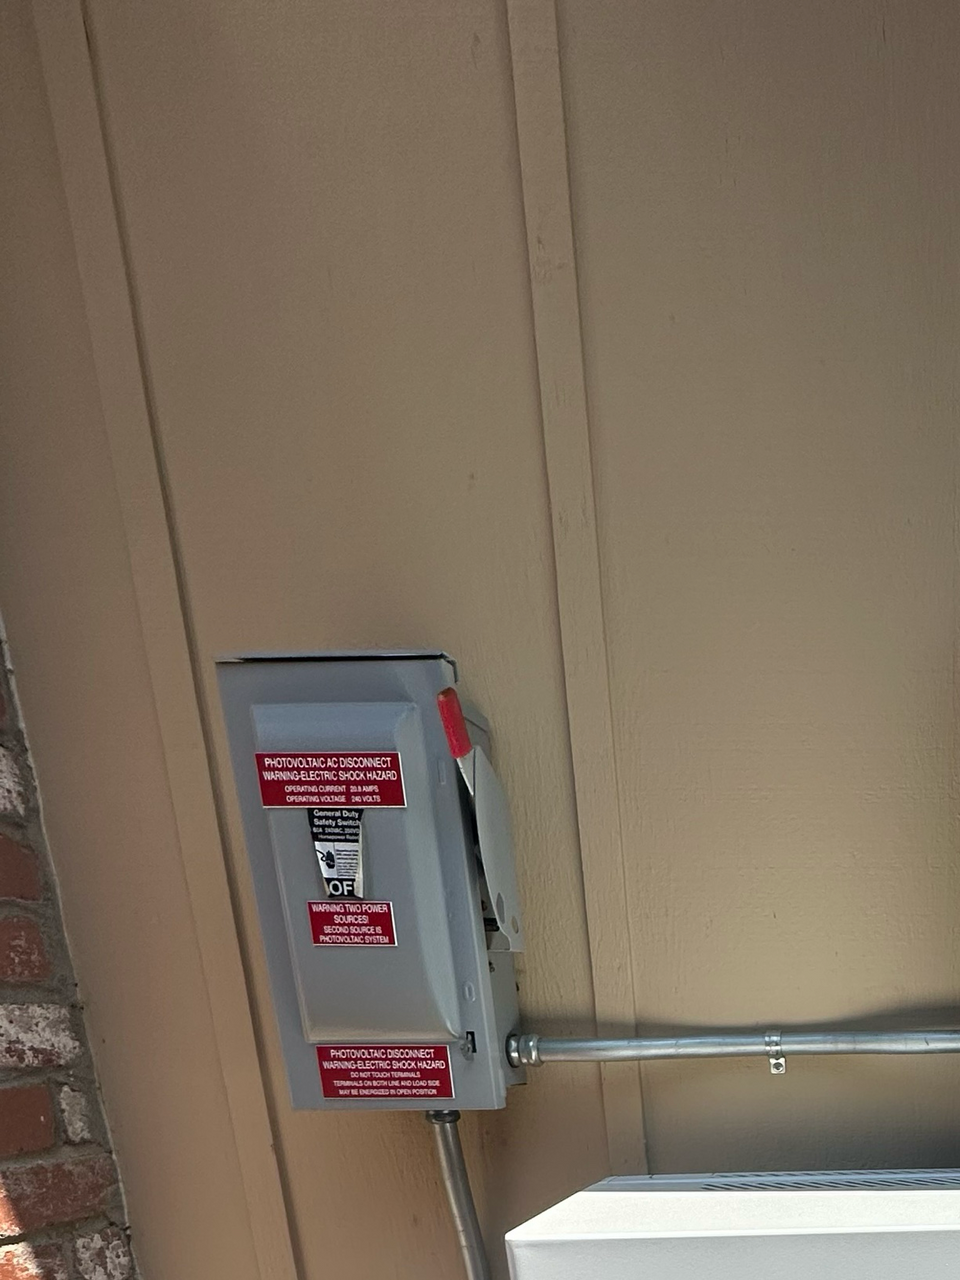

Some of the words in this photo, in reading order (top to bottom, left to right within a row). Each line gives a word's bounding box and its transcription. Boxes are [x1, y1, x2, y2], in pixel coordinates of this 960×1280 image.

[264, 757, 326, 768] PHOTOVOLTAIC
[327, 758, 338, 768] AC
[339, 758, 391, 768] DISCONNECT
[263, 771, 337, 780] WARNING-ELECTRIC
[339, 771, 365, 780] SHOCK
[367, 771, 397, 781] HAZARD
[342, 810, 359, 818] Duty
[312, 904, 344, 912] WARNING
[345, 904, 361, 912] TWO
[362, 904, 388, 913] POWER
[334, 915, 369, 923] SOURCES!
[320, 935, 364, 943] PHOTOVOLTAIC
[330, 1049, 386, 1058] PHOTOVOLTAIC
[388, 1049, 434, 1058] DISCONNECT
[323, 1060, 391, 1069] WARNING-ELECTRIC
[392, 1061, 416, 1069] SHOCK
[418, 1061, 446, 1069] HAZARD
